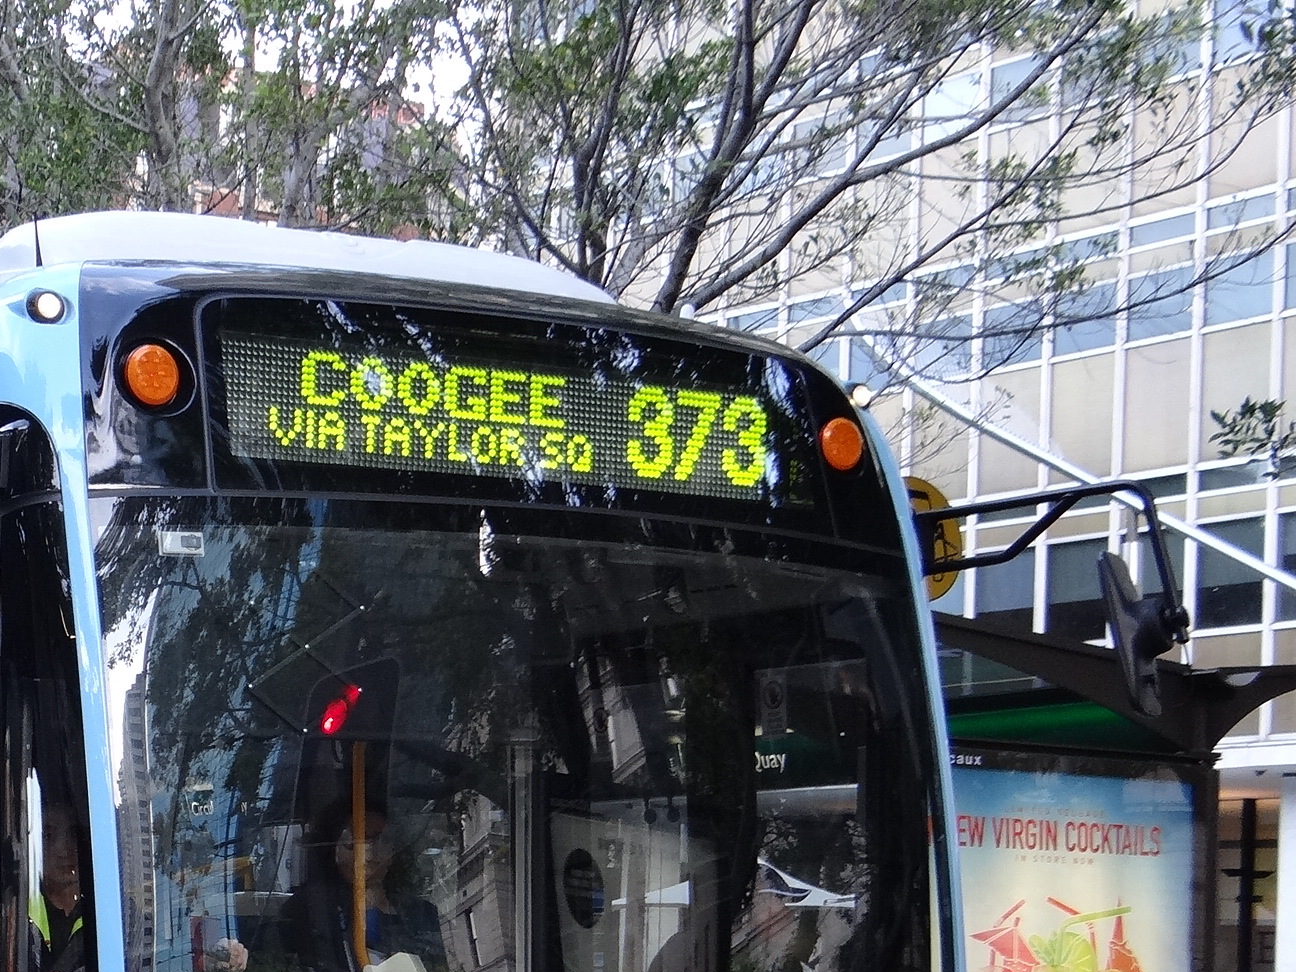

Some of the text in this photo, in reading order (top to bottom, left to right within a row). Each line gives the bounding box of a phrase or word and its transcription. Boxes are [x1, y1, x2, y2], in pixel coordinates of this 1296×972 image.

[300, 350, 567, 430] COOGEE
[268, 405, 593, 473] VIA TAYLOR SQ
[627, 386, 767, 488] 373
[755, 751, 786, 774] Quay
[956, 814, 1162, 857] EW VIRGIN COCKTAILS
